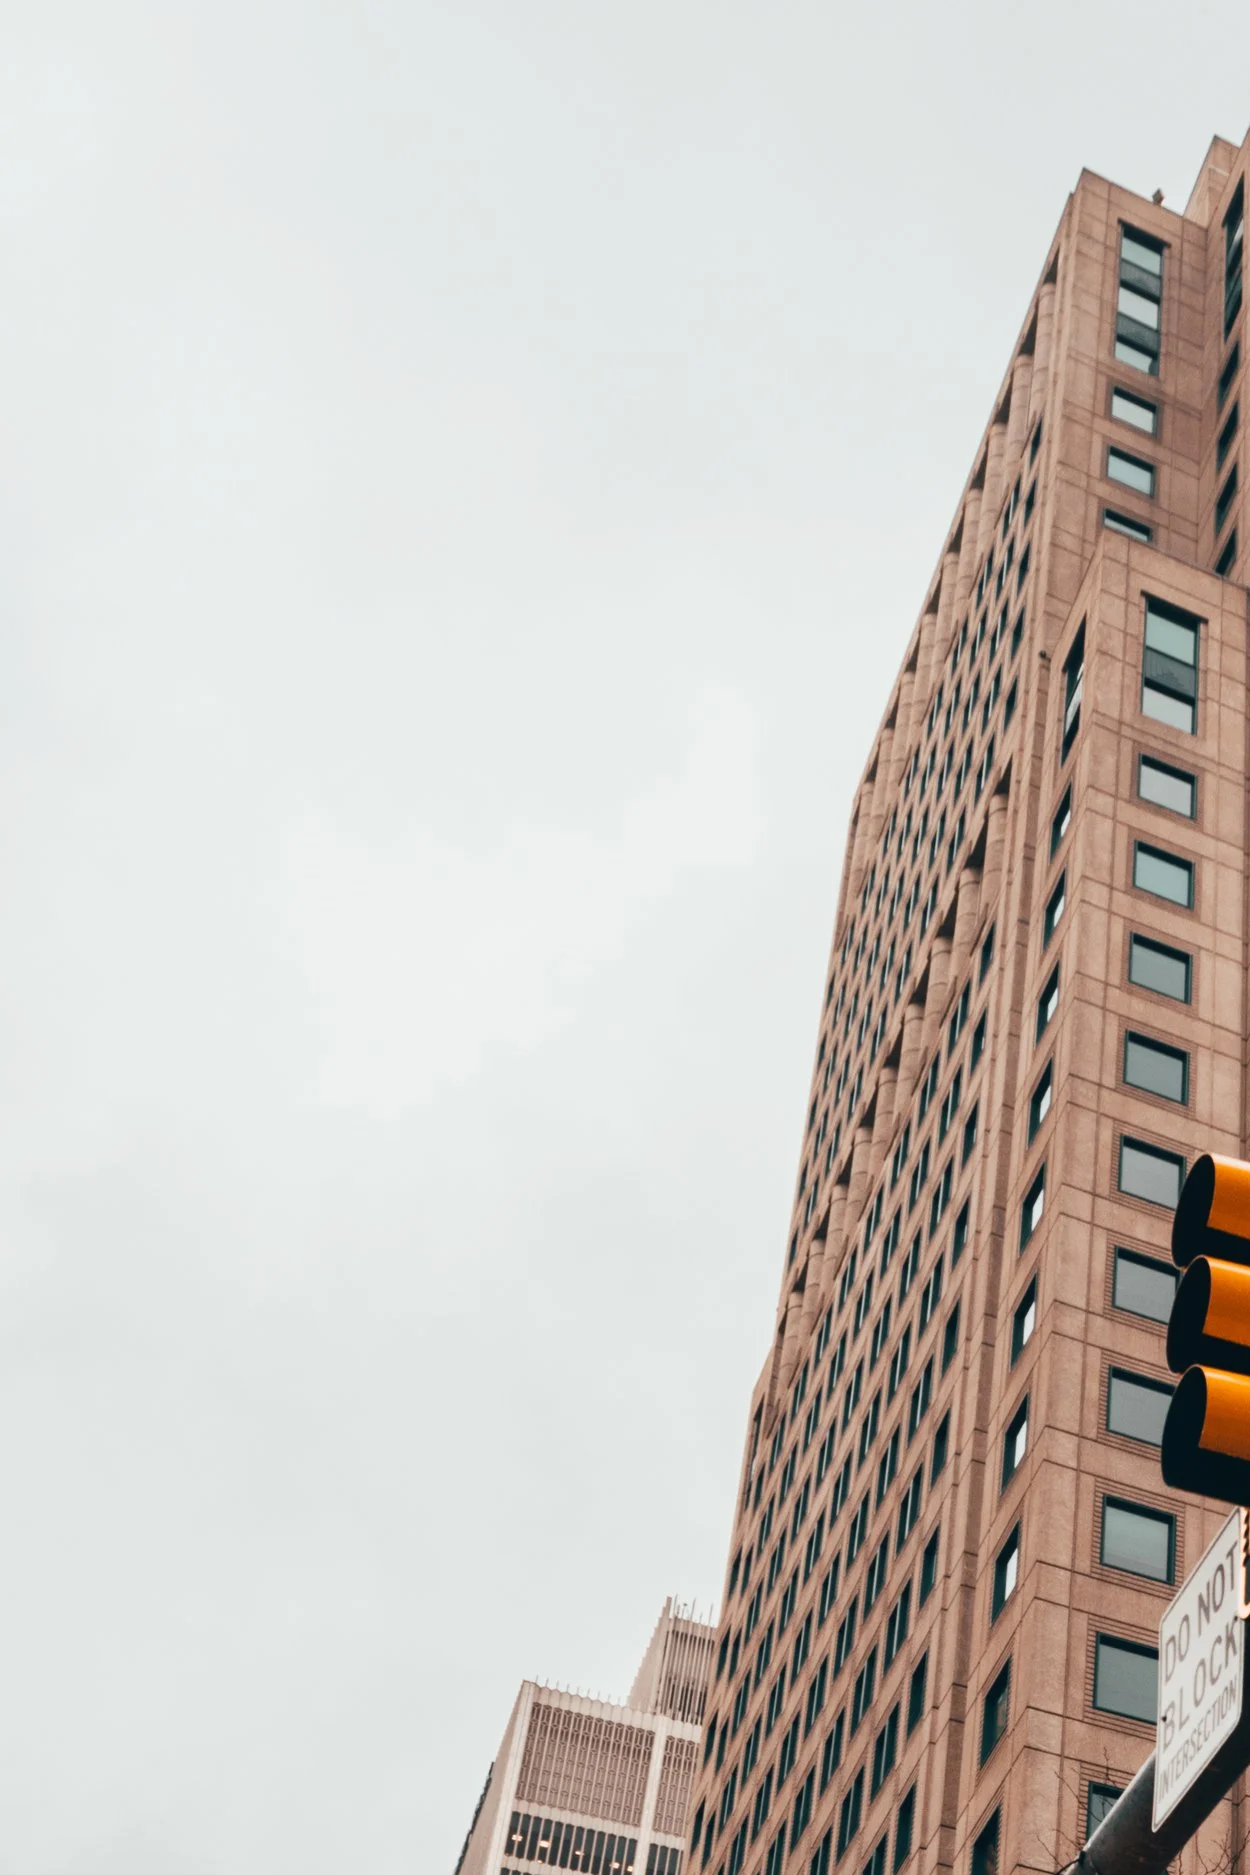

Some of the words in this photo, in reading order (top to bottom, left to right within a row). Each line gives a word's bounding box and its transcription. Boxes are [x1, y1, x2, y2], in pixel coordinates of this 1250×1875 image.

[1165, 1613, 1190, 1684] DO
[1198, 1540, 1238, 1637] NOT
[1159, 1673, 1237, 1804] INTERSECTION
[1163, 1619, 1237, 1751] BLOCK
